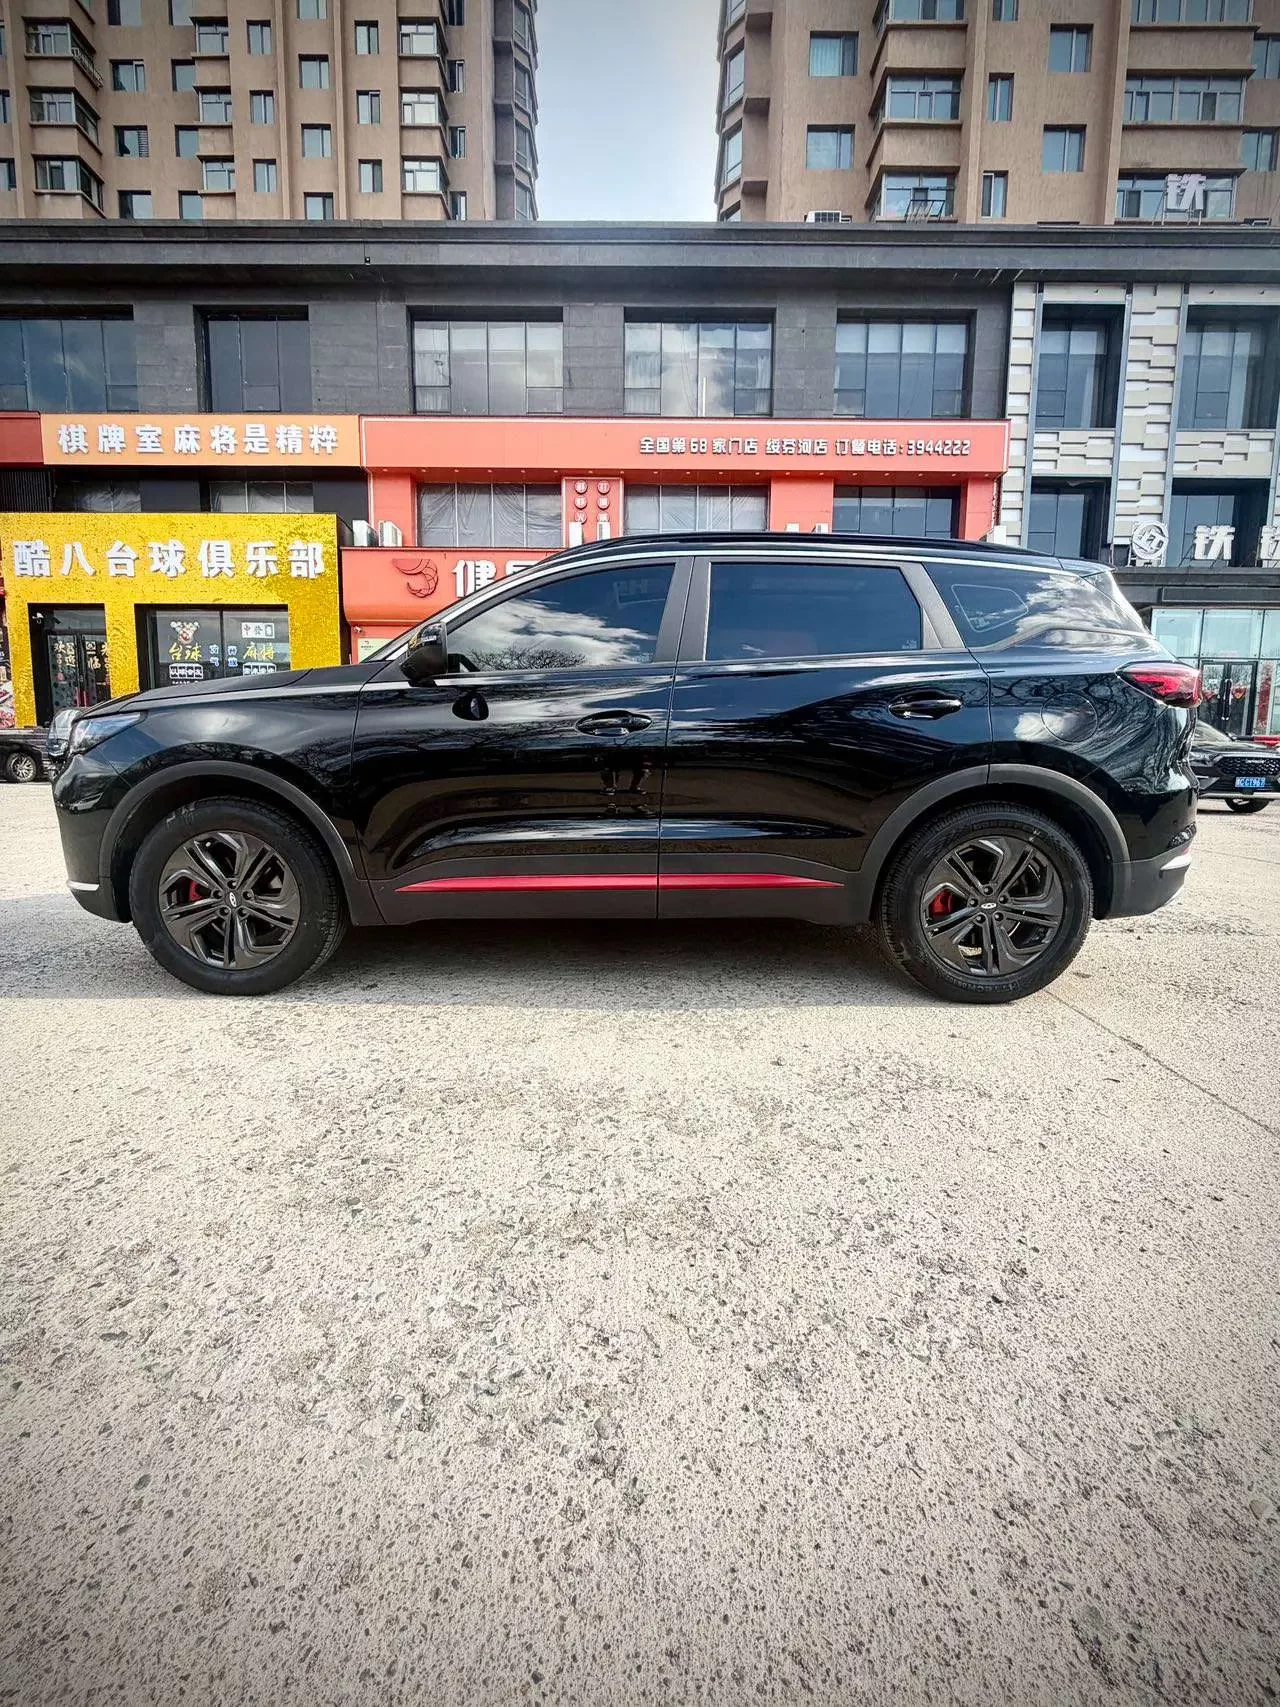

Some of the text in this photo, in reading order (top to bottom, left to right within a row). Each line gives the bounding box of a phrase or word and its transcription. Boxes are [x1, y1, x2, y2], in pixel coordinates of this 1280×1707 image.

[57, 423, 338, 454] 棋牌室麻将是精粹
[640, 436, 758, 455] 全国第68家门店
[766, 438, 829, 455] 绥芬河店
[13, 540, 325, 578] 酷八台球俱乐部
[168, 642, 203, 661] 台球
[243, 641, 276, 661] 麻将
